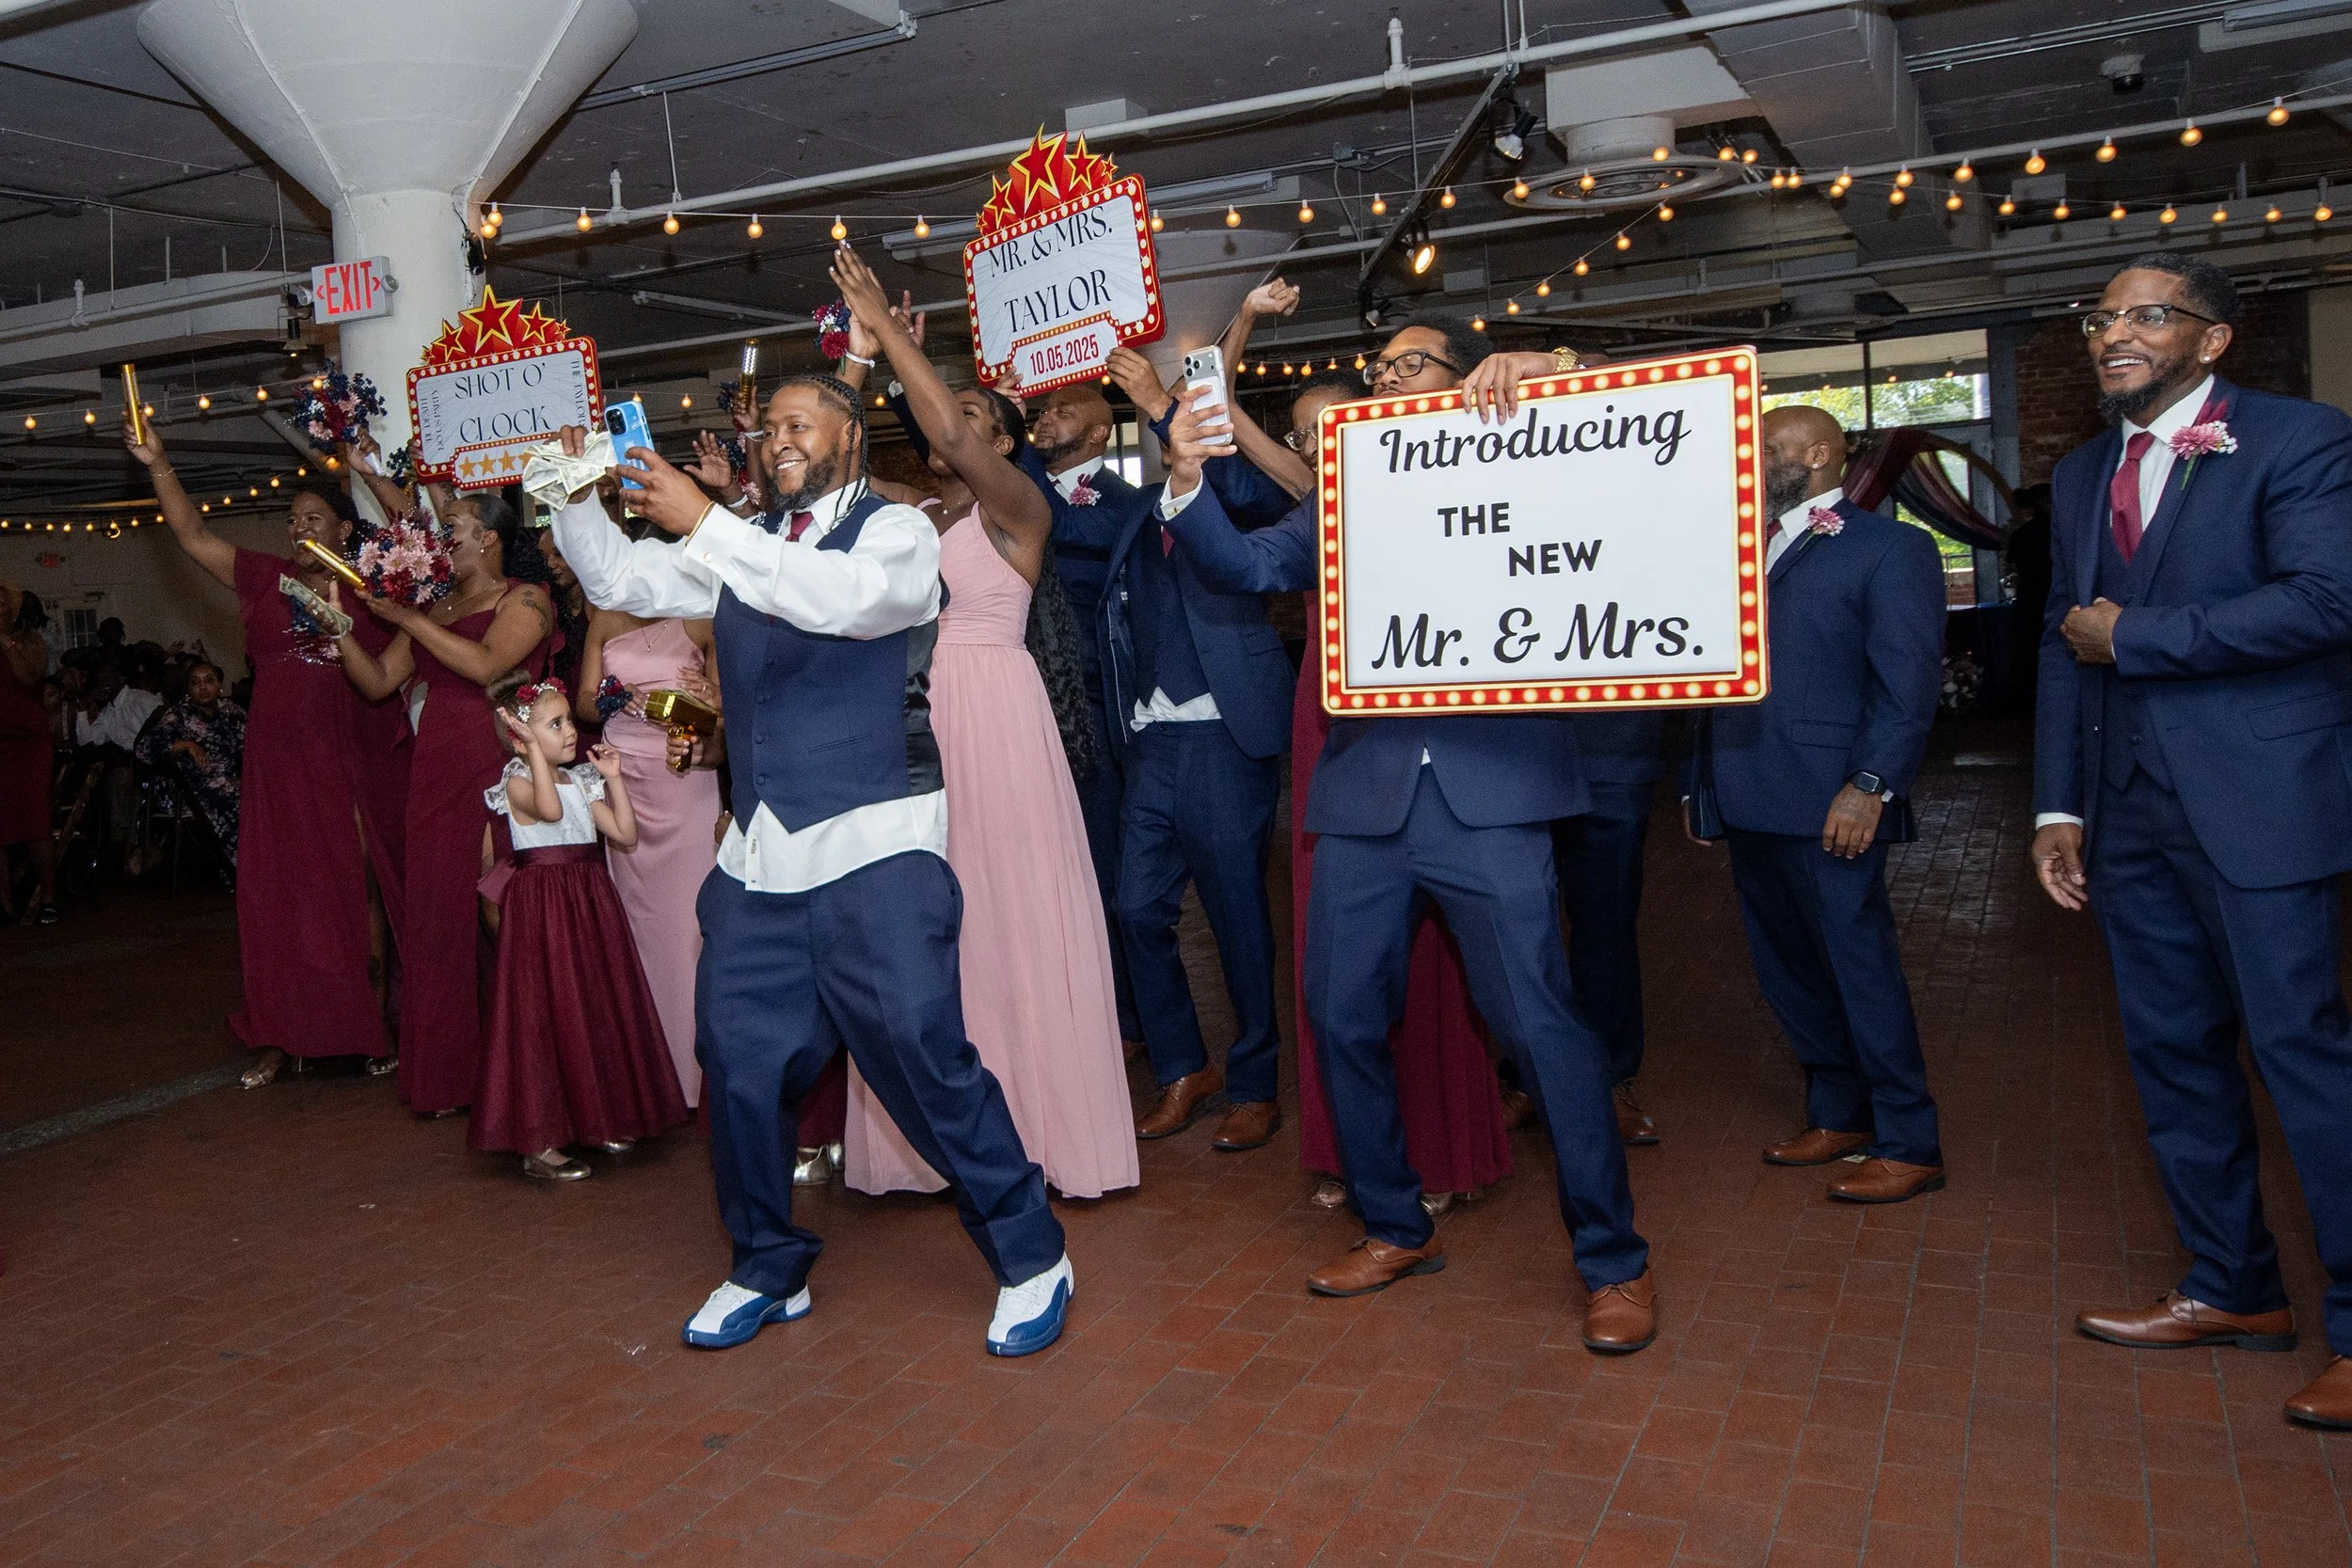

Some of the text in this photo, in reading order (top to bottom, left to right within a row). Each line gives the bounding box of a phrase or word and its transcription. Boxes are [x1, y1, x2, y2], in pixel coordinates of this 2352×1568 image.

[989, 205, 1113, 277] MR. & MRS.
[325, 261, 372, 315] EXIT
[1004, 269, 1112, 333] TAYLOR
[570, 357, 581, 379] THE
[1029, 334, 1100, 376] 10.05.2025
[454, 368, 515, 400] SHOT
[459, 405, 551, 443] CLOCK
[1379, 404, 1692, 473] Introducing
[1438, 502, 1510, 538] THE
[1508, 539, 1602, 577] NEW
[1372, 601, 1704, 670] Mr. & Mrs.
